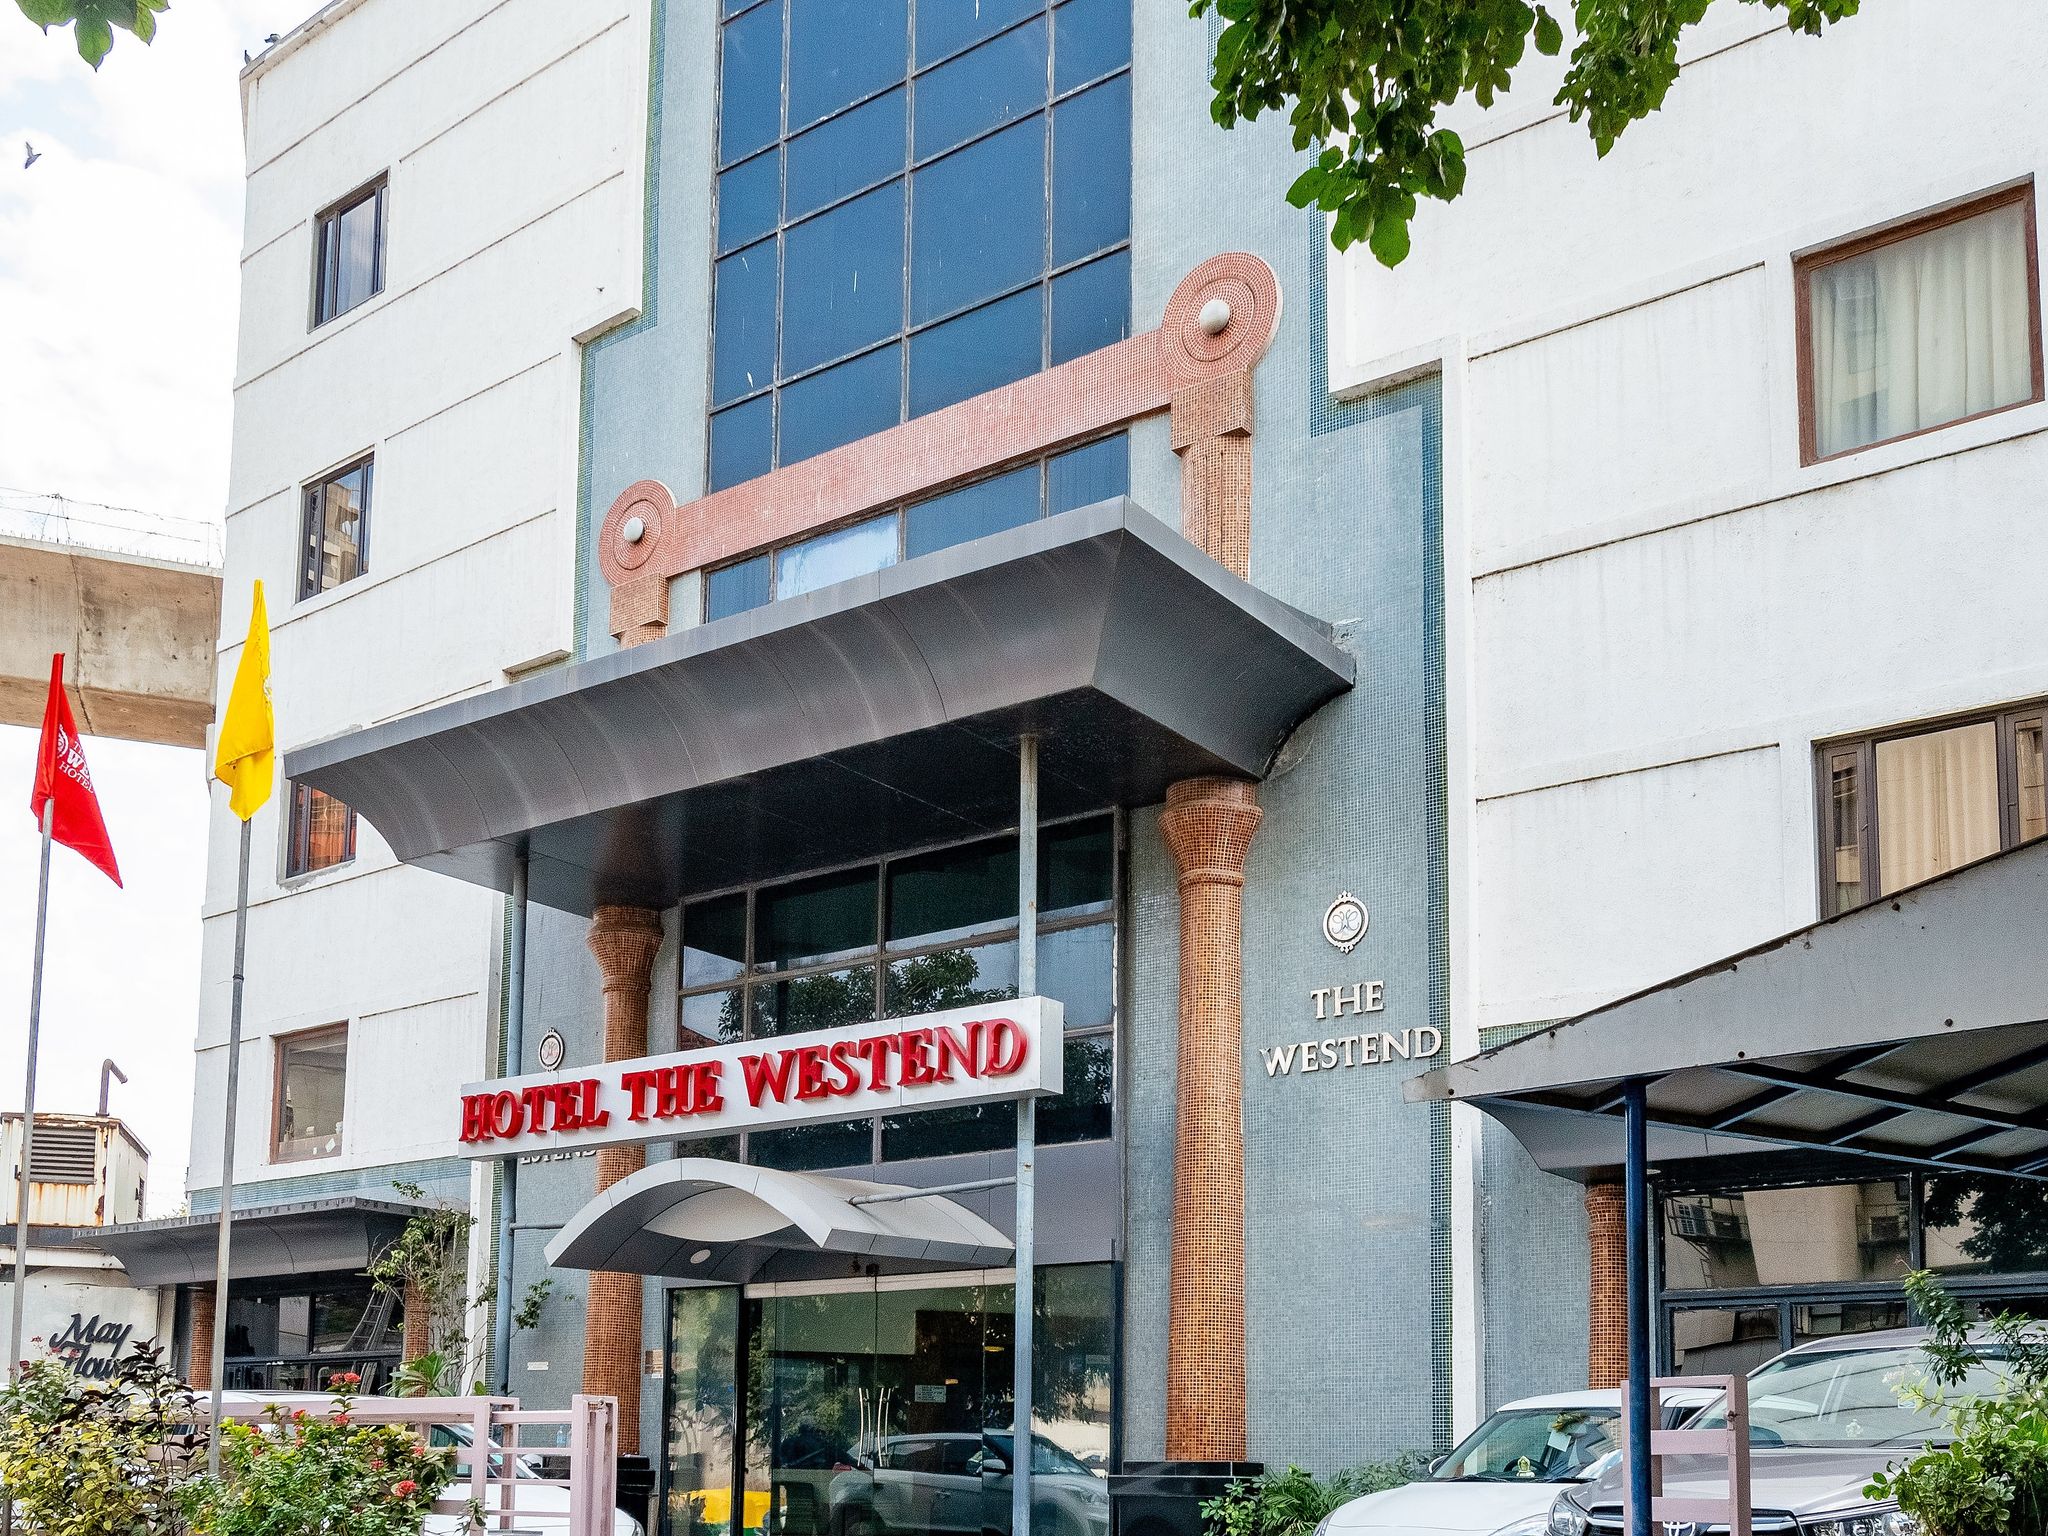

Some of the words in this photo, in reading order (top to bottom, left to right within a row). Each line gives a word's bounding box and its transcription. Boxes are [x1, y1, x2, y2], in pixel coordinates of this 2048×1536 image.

[1310, 980, 1386, 1020] THE
[1259, 1026, 1443, 1078] WESTEND
[459, 1078, 611, 1143] HOTEL
[621, 1060, 725, 1122] THE
[737, 1017, 1029, 1108] WESTEND
[49, 1313, 133, 1358] May
